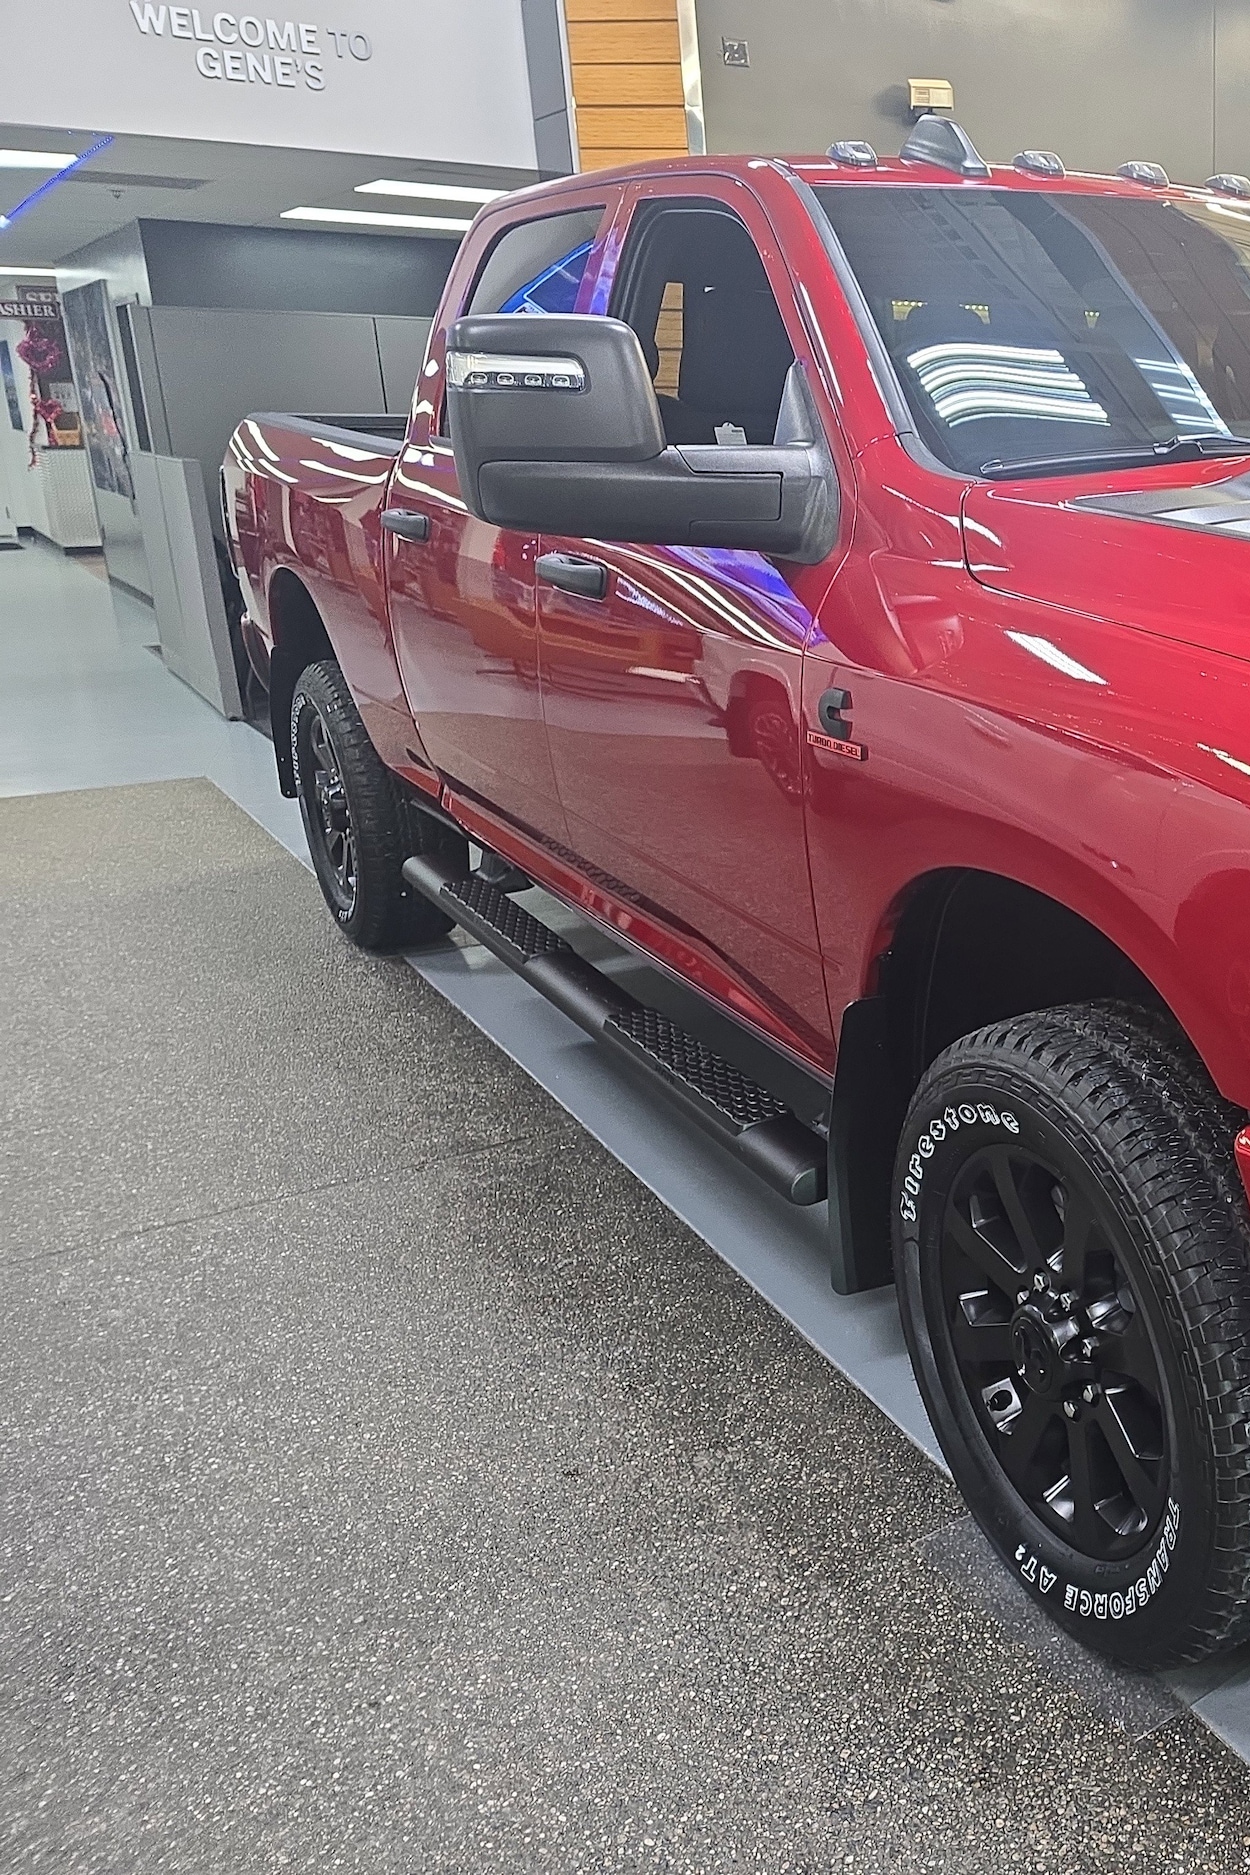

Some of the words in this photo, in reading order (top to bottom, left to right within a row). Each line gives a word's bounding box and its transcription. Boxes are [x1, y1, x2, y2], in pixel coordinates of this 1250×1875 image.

[129, 0, 321, 55] WELCOME
[326, 27, 373, 61] TO
[195, 47, 327, 91] GENE'S
[808, 733, 832, 749] TURBO
[833, 741, 861, 758] DIESEL
[1063, 1496, 1182, 1620] TRANSFORCE
